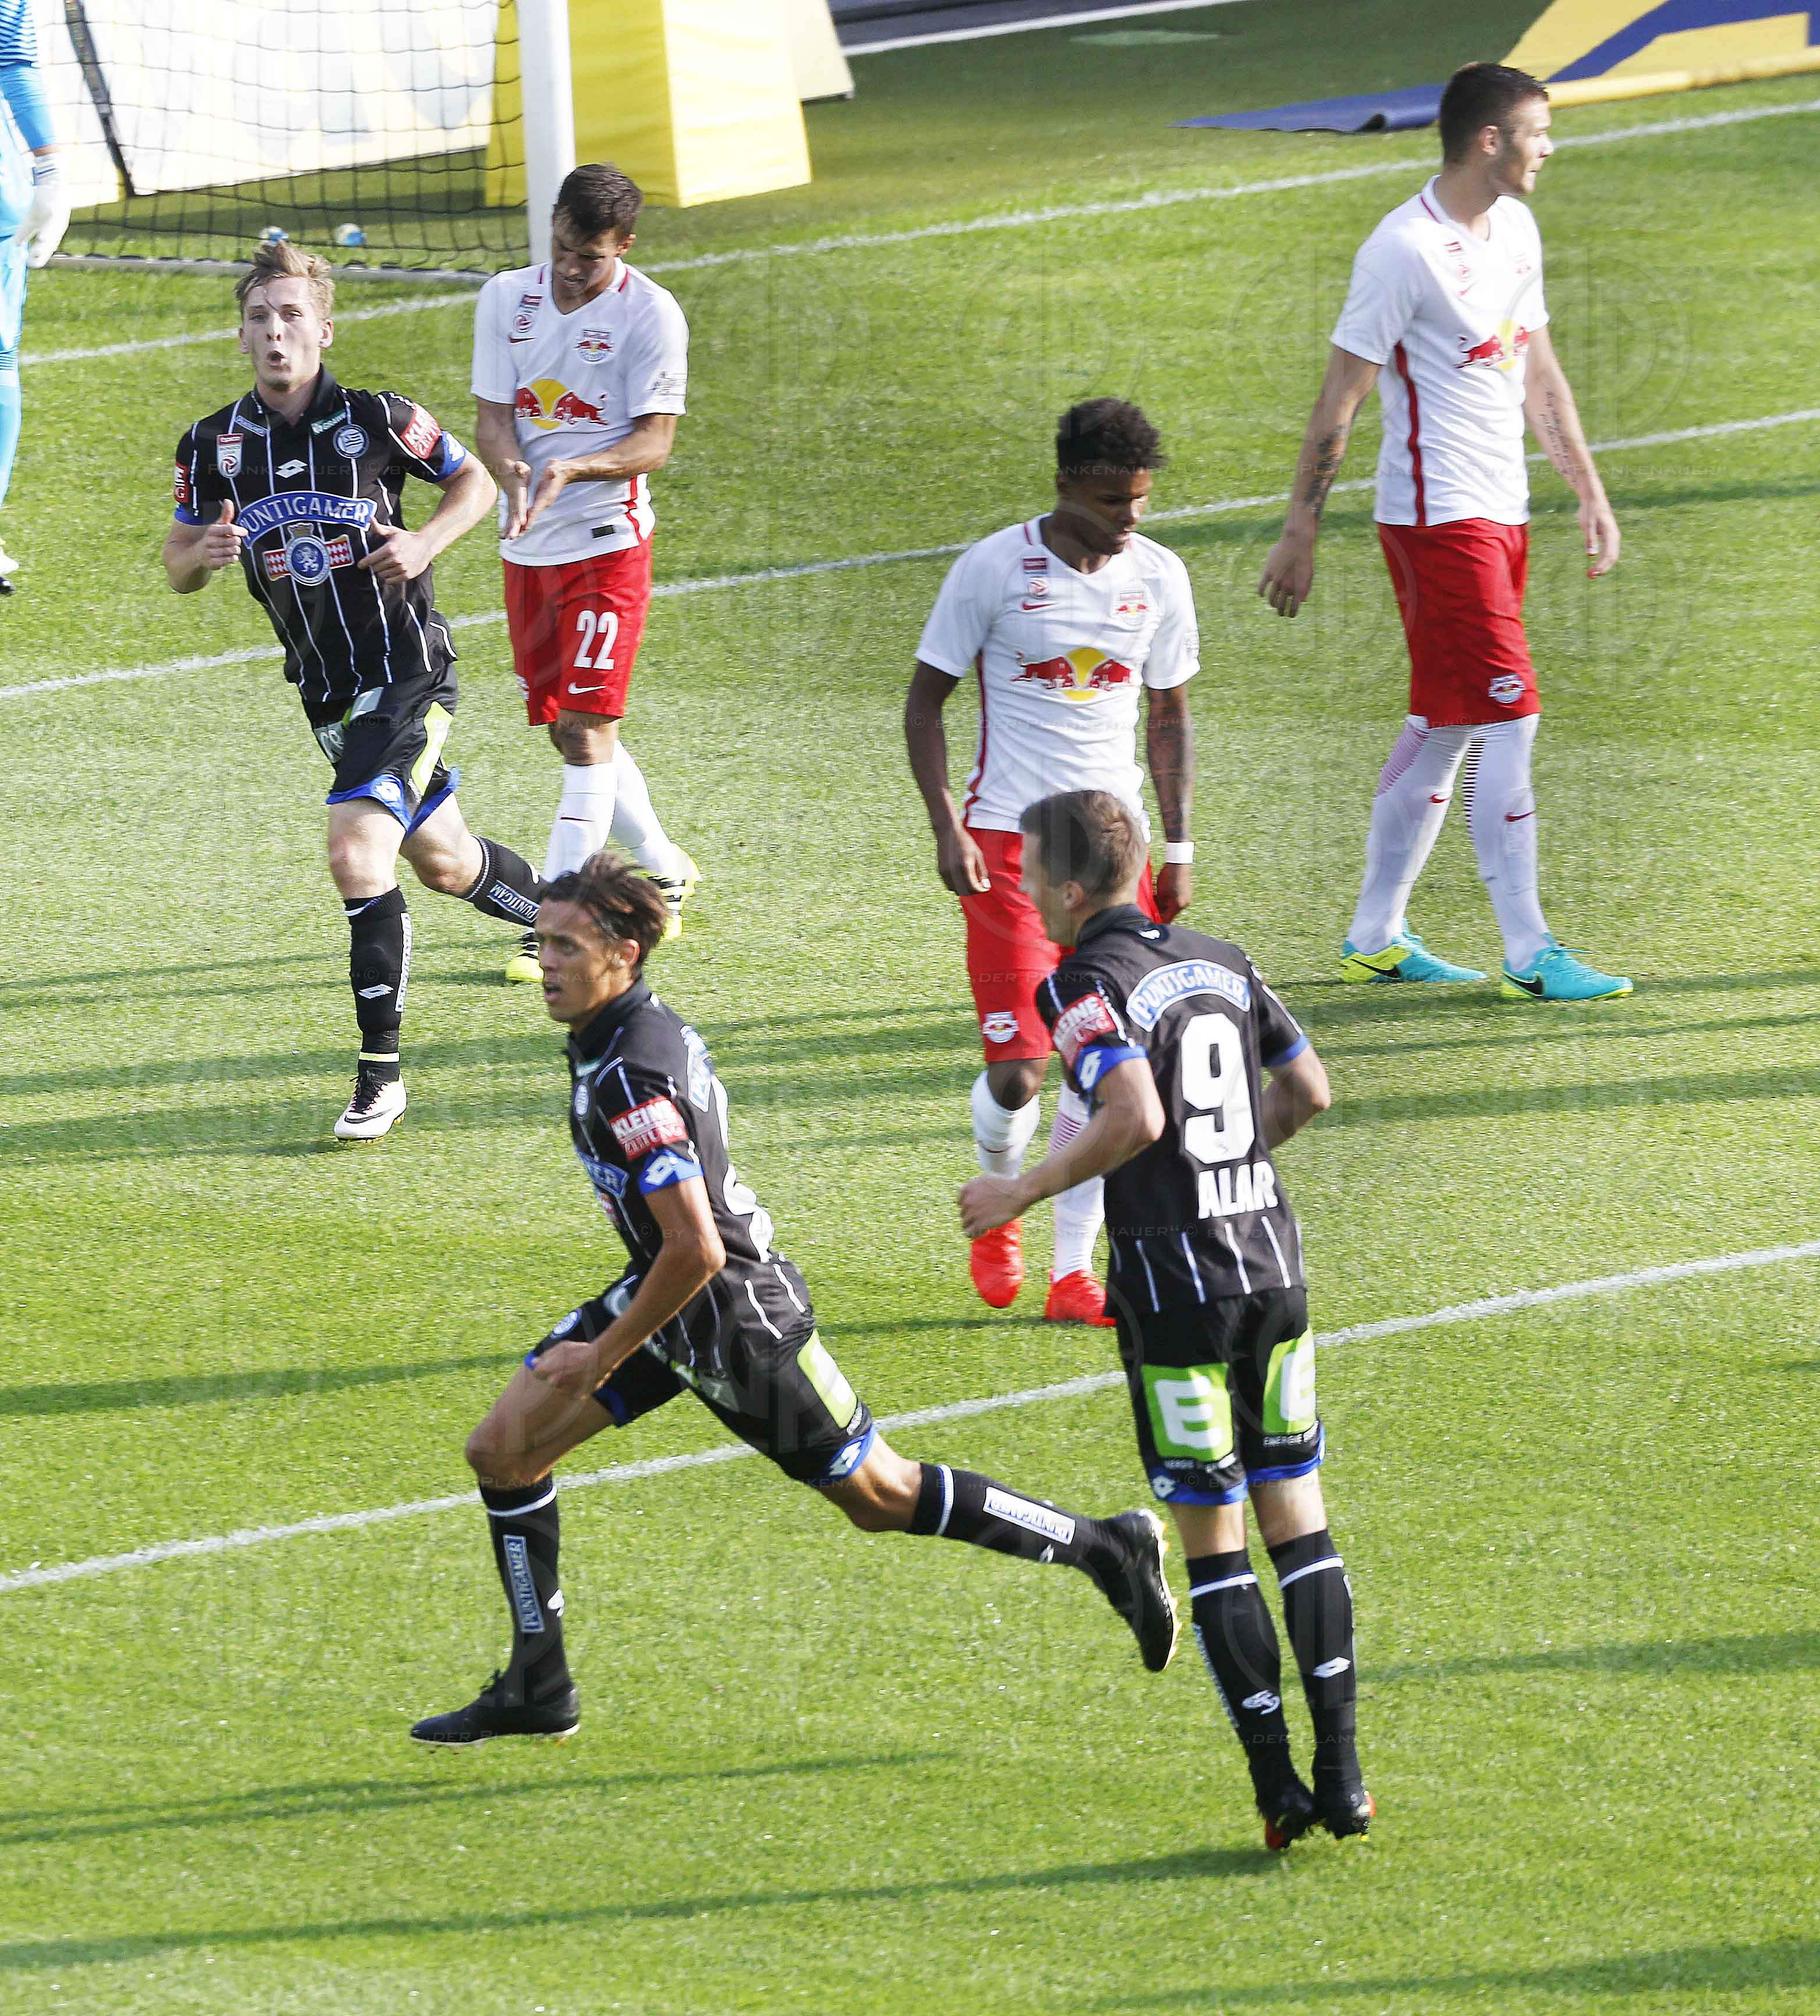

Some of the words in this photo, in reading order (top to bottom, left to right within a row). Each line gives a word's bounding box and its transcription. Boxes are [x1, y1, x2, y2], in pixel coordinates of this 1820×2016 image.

[573, 609, 618, 670] 22
[1133, 966, 1246, 1019] PUNTIGAMER
[1181, 1012, 1256, 1165] 9
[611, 1099, 677, 1140] KLEINE
[1198, 1160, 1279, 1219] ALAR
[1154, 1375, 1222, 1449] E
